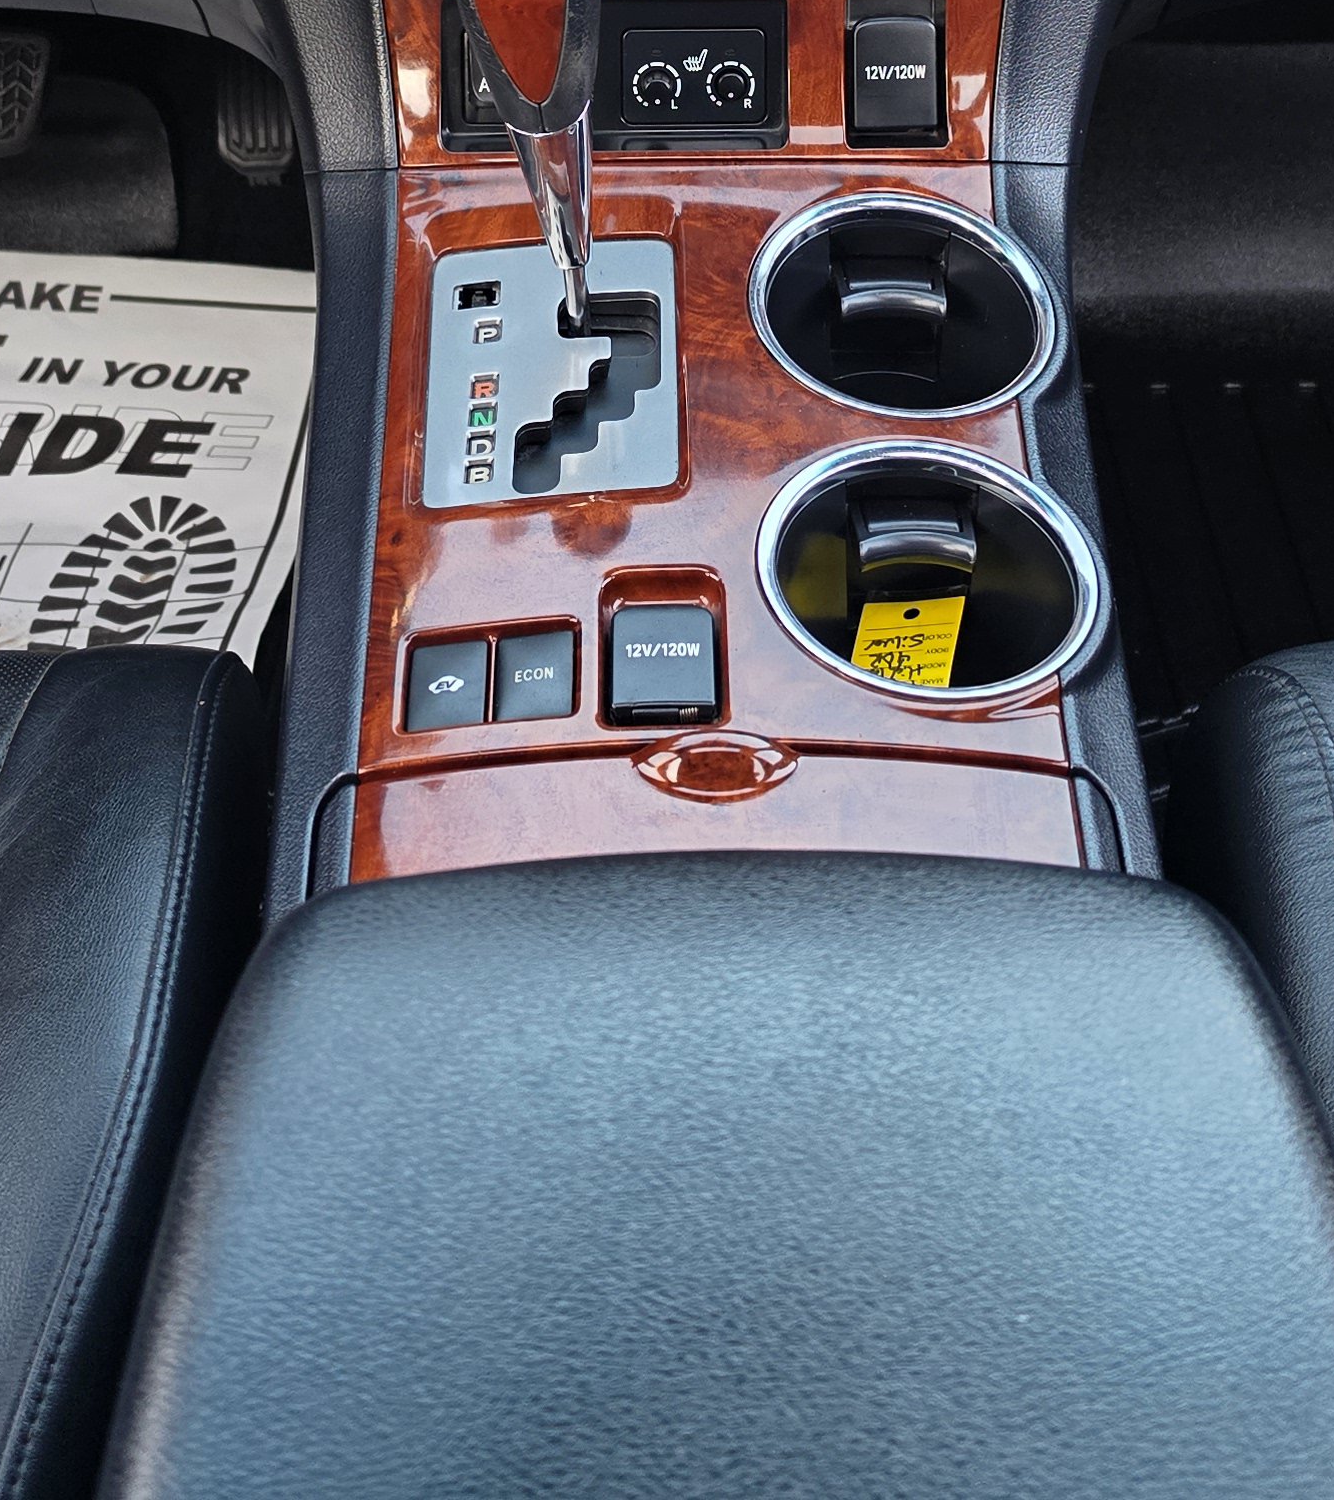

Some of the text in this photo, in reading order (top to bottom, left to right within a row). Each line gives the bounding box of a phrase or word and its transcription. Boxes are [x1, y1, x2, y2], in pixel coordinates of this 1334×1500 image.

[865, 65, 926, 81] 12V/120W
[671, 99, 679, 110] L
[743, 99, 752, 109] R
[478, 327, 497, 343] P
[18, 356, 79, 386] IN
[103, 359, 250, 395] YOUR
[474, 382, 494, 398] R
[473, 411, 494, 425] N
[471, 439, 492, 455] D
[469, 466, 490, 484] B
[864, 634, 925, 650] Silver
[625, 642, 700, 659] 12V/120W
[514, 667, 554, 683] ECON
[435, 680, 457, 690] EV
